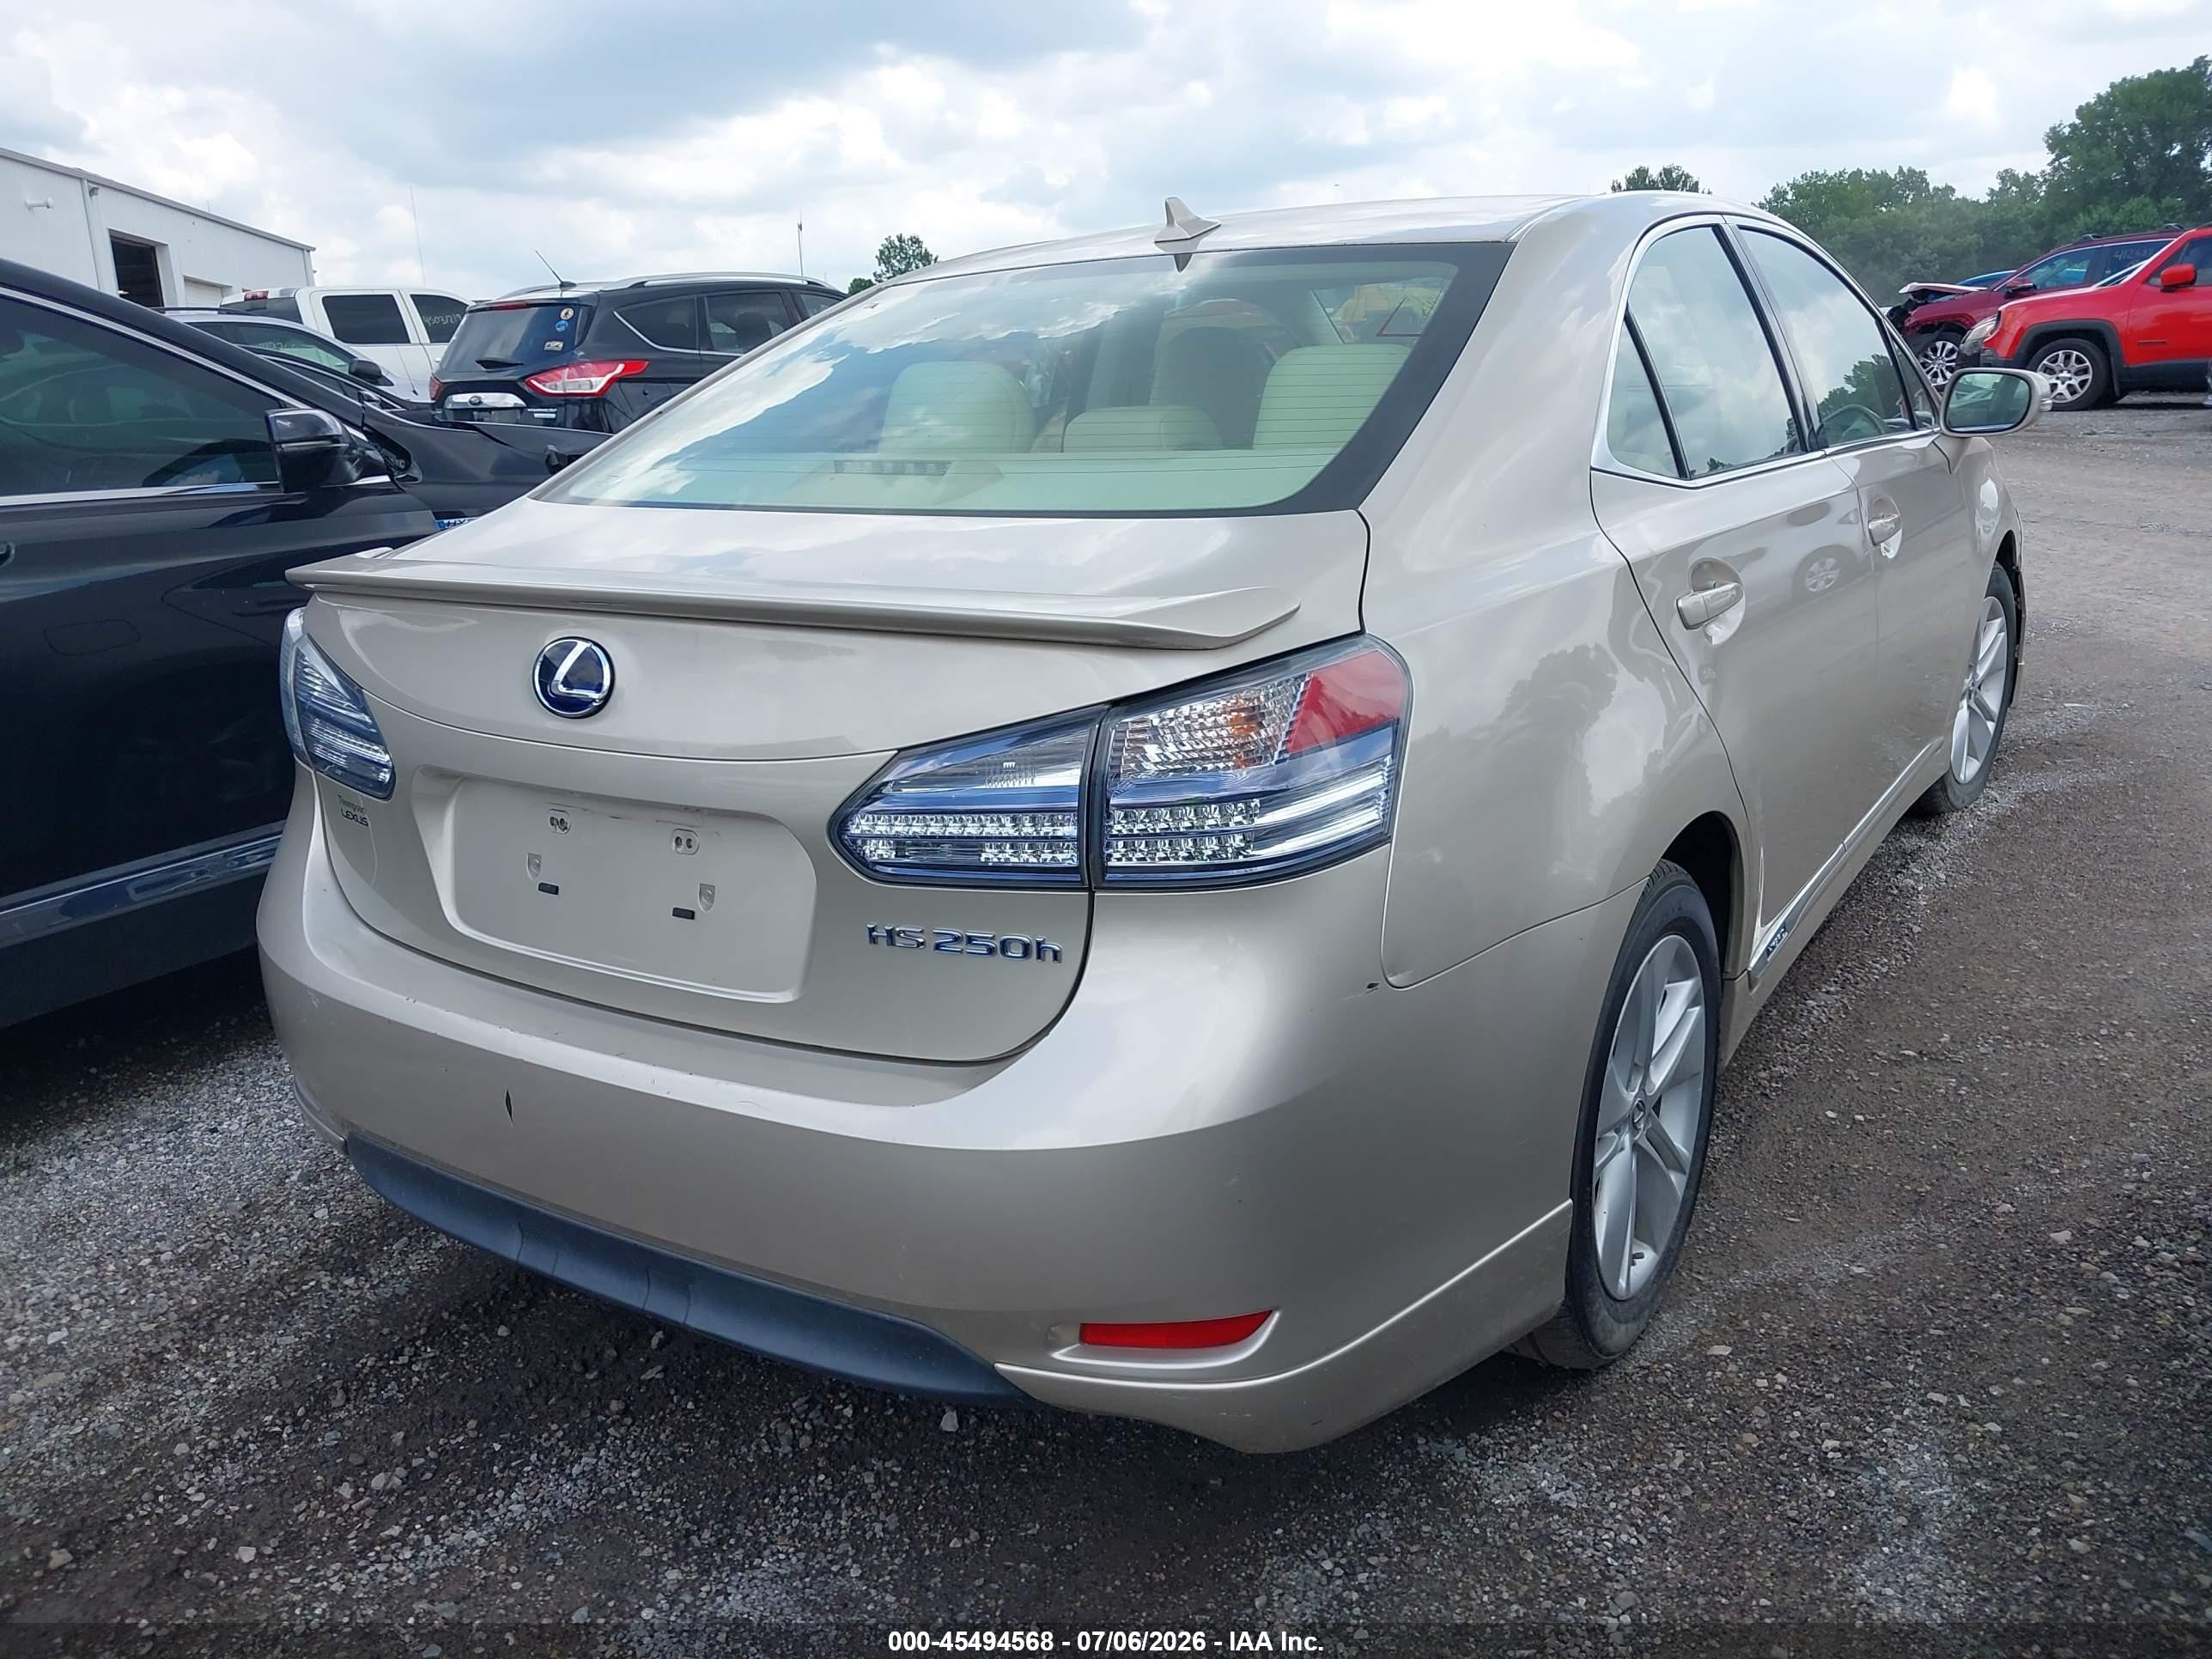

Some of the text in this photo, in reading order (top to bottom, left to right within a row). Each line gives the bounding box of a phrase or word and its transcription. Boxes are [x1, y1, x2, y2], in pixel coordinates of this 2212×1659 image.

[340, 806, 369, 827] LEXUS
[866, 922, 1063, 963] HS 250h
